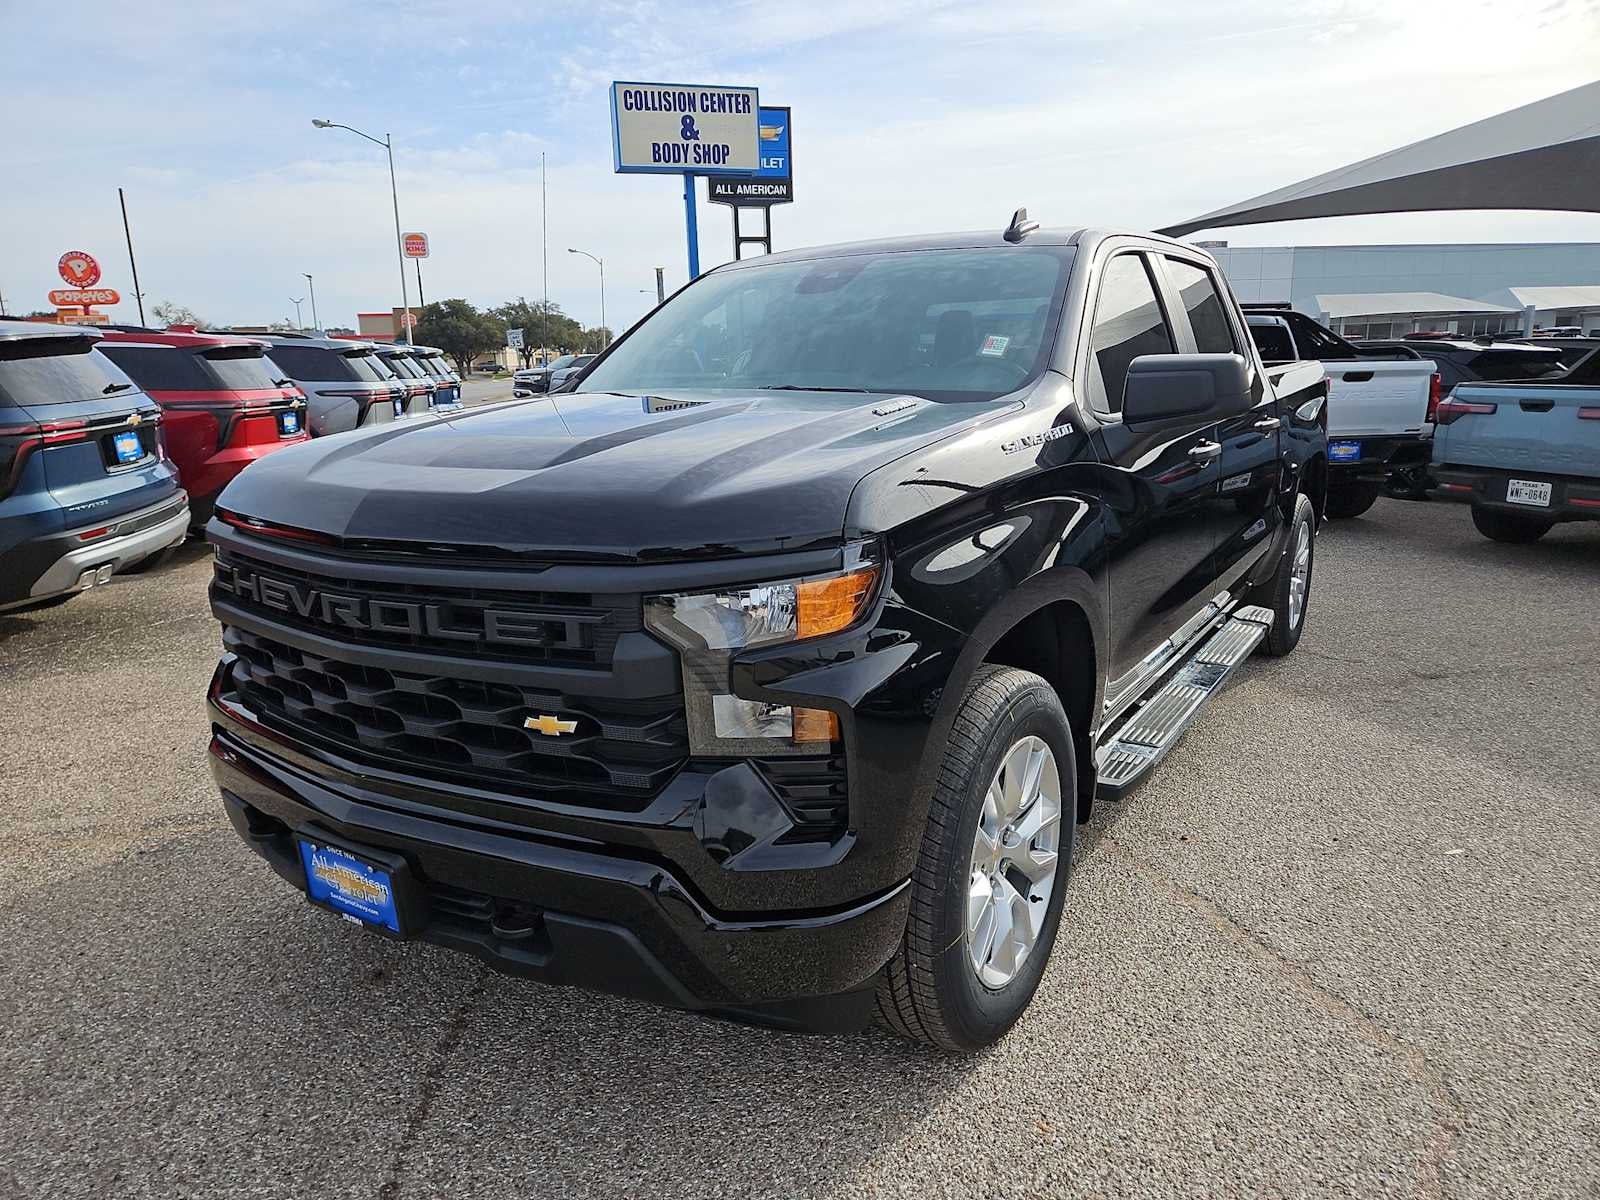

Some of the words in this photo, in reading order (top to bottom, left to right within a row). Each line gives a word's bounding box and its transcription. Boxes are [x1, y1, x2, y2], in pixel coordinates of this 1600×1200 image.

[623, 89, 697, 112] COLLISION
[700, 92, 751, 114] CENTER
[680, 114, 700, 141] &
[652, 142, 690, 164] BODY
[693, 143, 730, 165] SHOP
[715, 184, 734, 195] ALL
[736, 184, 787, 195] AMERICAN
[214, 560, 612, 649] CHEVROLET
[311, 853, 330, 870] All
[333, 861, 389, 895] American
